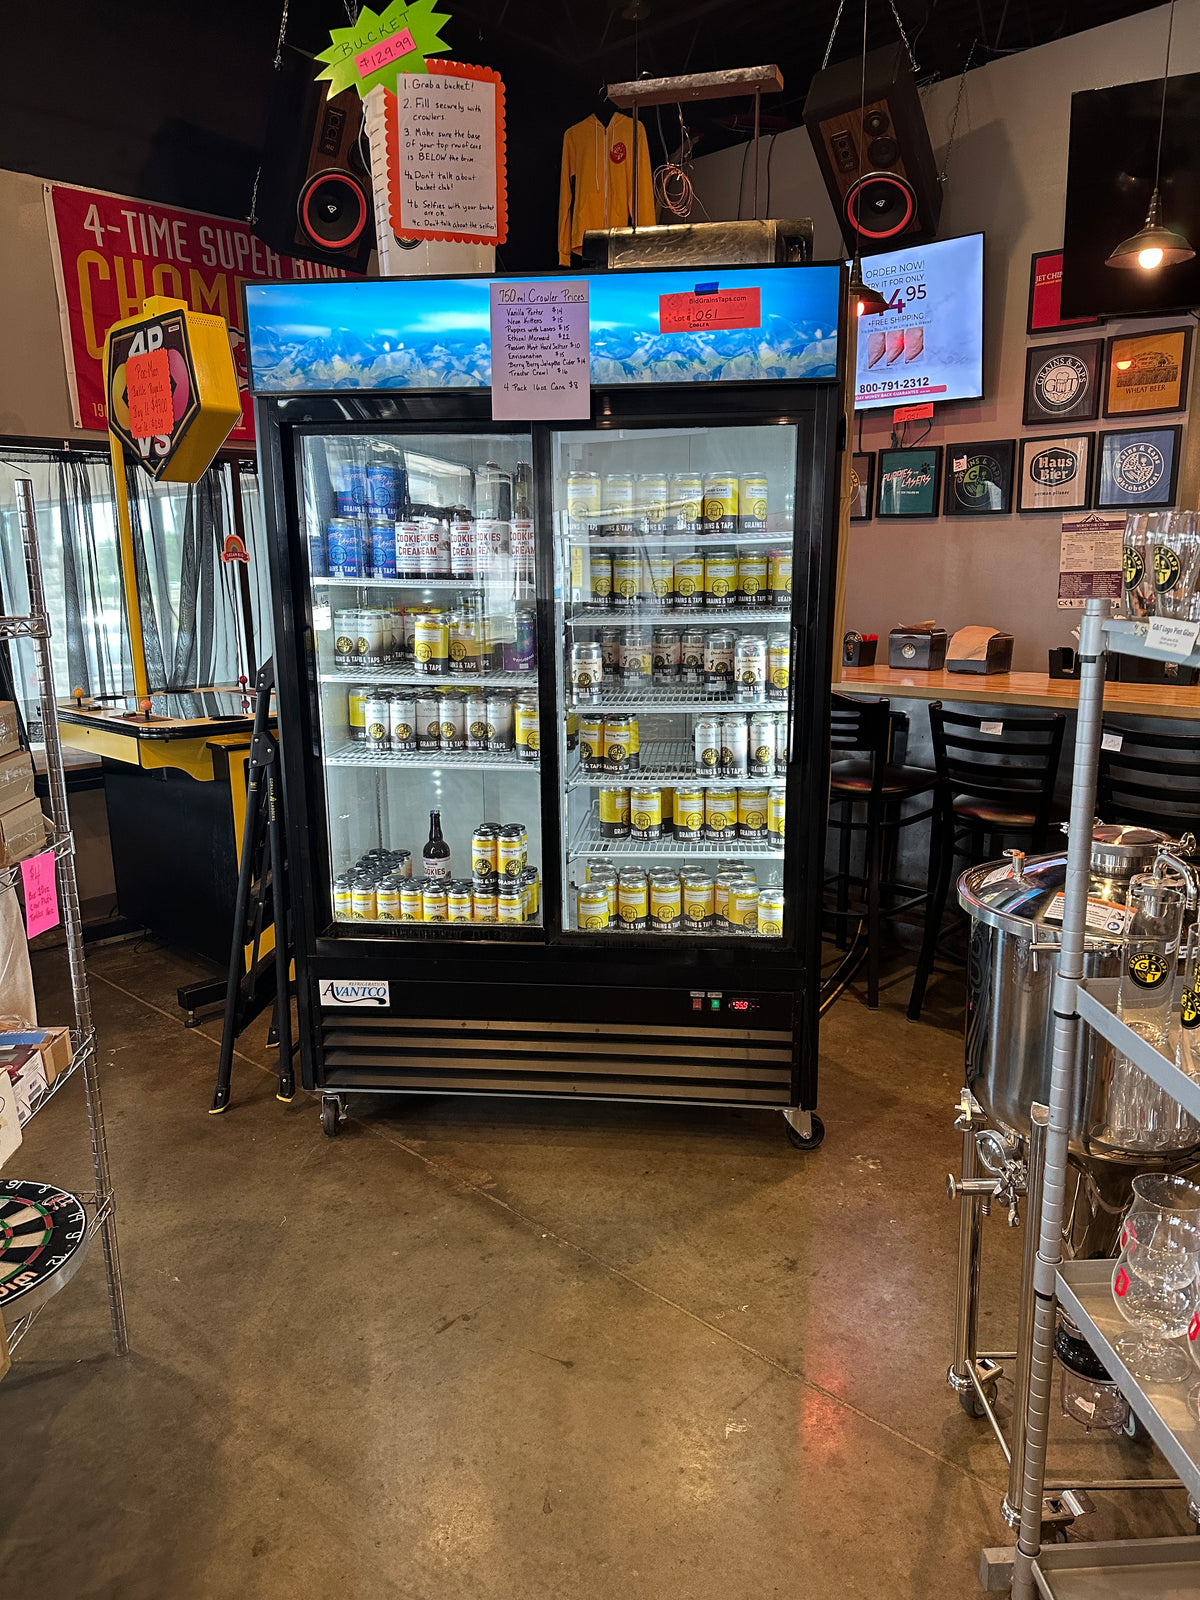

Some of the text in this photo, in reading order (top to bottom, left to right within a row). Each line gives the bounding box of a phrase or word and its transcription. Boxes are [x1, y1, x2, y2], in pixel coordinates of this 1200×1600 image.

[335, 10, 410, 66] BUCKET
[359, 37, 413, 67] $129.99
[403, 79, 411, 90] 1.
[412, 79, 434, 89] Grab
[444, 80, 474, 92] bucket!
[403, 98, 482, 113] 2. Fill securely with
[413, 113, 446, 121] crowlers.
[404, 128, 482, 141] 3. Make sure the base
[406, 140, 416, 148] of
[419, 143, 435, 152] your
[436, 141, 449, 151] top
[407, 152, 414, 161] is
[418, 153, 446, 161] BELOW
[414, 171, 434, 180] Don't
[438, 171, 453, 180] talk
[415, 181, 453, 191] bucket club!
[422, 201, 445, 209] Selfies
[447, 201, 461, 210] with
[462, 204, 476, 213] your
[479, 203, 495, 211] bucket
[452, 221, 468, 229] about
[469, 221, 478, 229] the
[83, 203, 283, 279] 4-TIME SUPER
[865, 260, 926, 279] ORDER NOW!
[881, 280, 888, 288] IT
[889, 278, 904, 287] FOR
[905, 274, 925, 284] ONLY
[1035, 274, 1047, 284] JET
[499, 288, 585, 303] 750 ml Crowler Prices
[689, 296, 747, 304] BidGrainsTaps.com
[552, 307, 563, 315] $14
[695, 309, 718, 321] 061
[890, 313, 925, 324] SHIPPING
[128, 325, 164, 358] 4P
[1037, 357, 1087, 386] GRAINS & TAPS
[503, 382, 509, 391] 4
[551, 382, 565, 390] Cans
[568, 381, 578, 390] $8
[860, 379, 930, 394] 800-791-2312
[1125, 384, 1166, 394] WHEAT BEER
[138, 433, 172, 459] VS
[1038, 456, 1073, 469] Haus
[1116, 445, 1137, 468] Grains
[1147, 445, 1161, 466] Taps
[882, 468, 931, 490] PUPPIES LASERS
[1040, 469, 1069, 481] Bier
[1117, 472, 1160, 492] Oktoberfest
[1167, 552, 1179, 571] TAPS
[1162, 625, 1173, 635] Logo
[429, 663, 442, 671] TAPS
[679, 830, 696, 838] GRAINS
[1129, 954, 1149, 969] GRAINS
[322, 982, 387, 1001] AVANTCO
